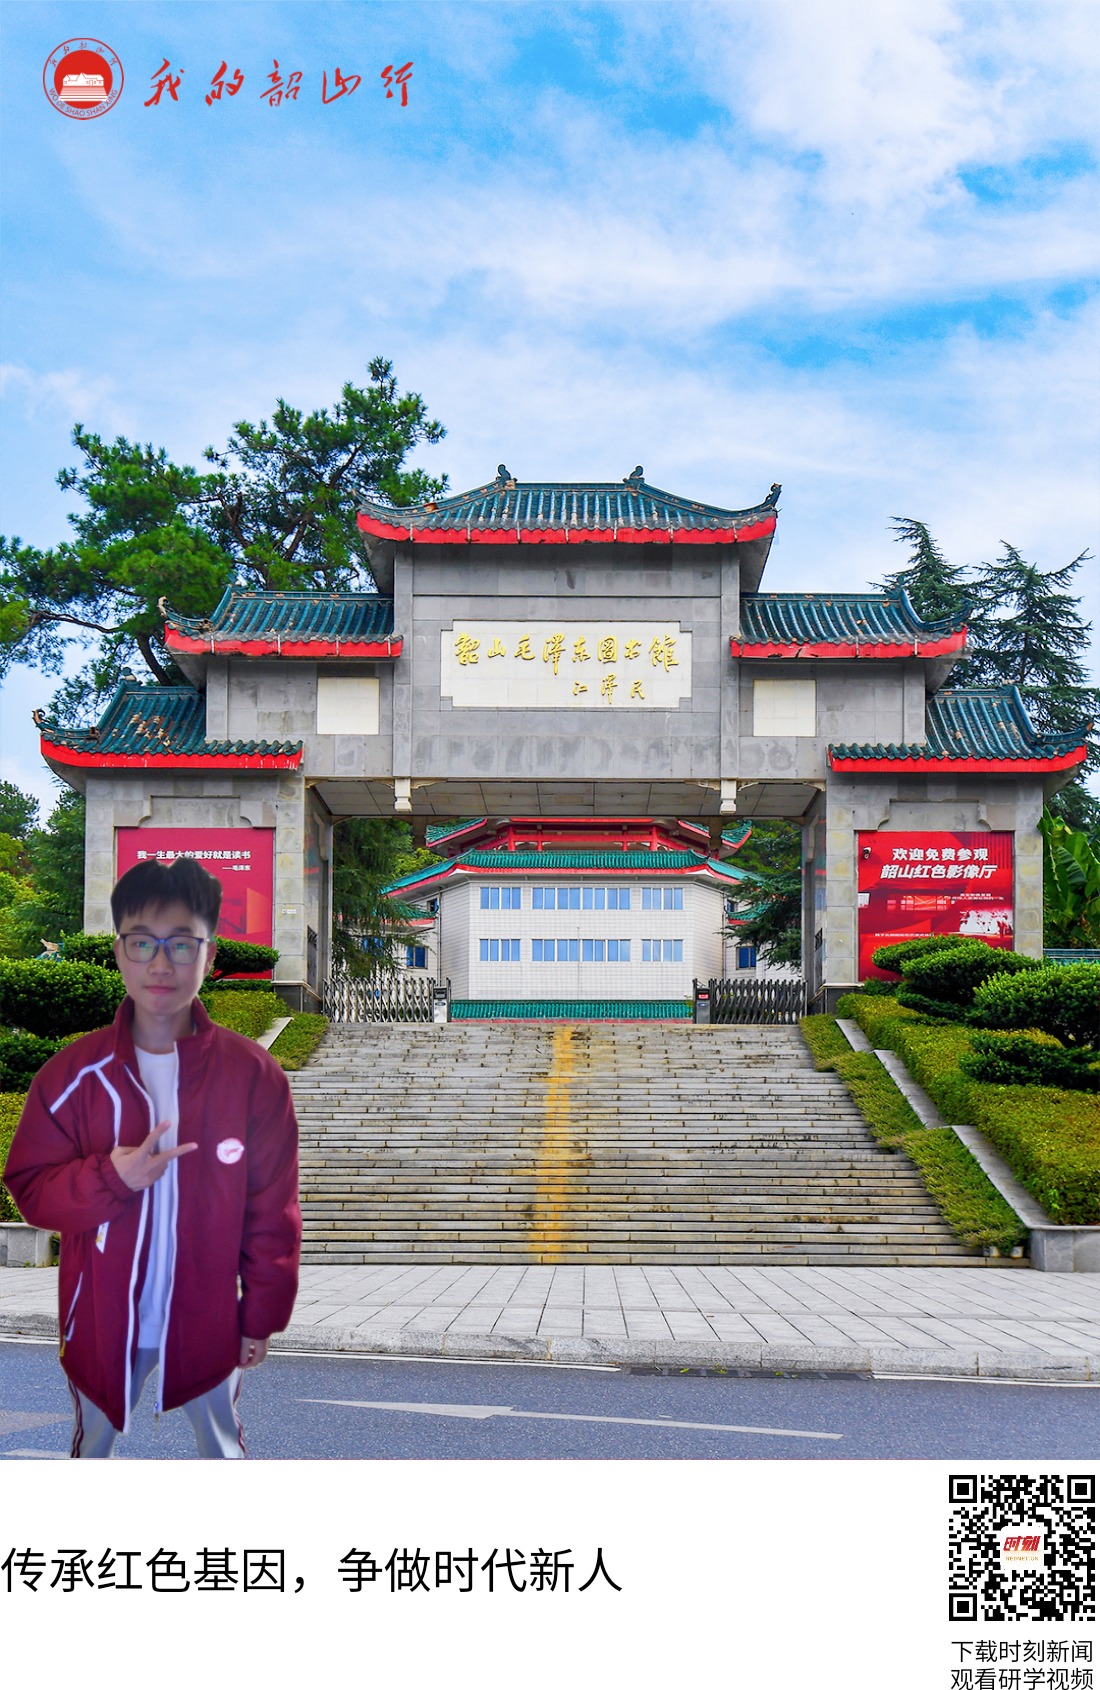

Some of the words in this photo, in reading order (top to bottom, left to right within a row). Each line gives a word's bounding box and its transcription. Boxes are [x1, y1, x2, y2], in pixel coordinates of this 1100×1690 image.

[136, 850, 252, 860] 我一生最大的爱好就是读书
[892, 847, 989, 862] 欢迎免费参观
[880, 864, 998, 879] 韶山红色影像厅
